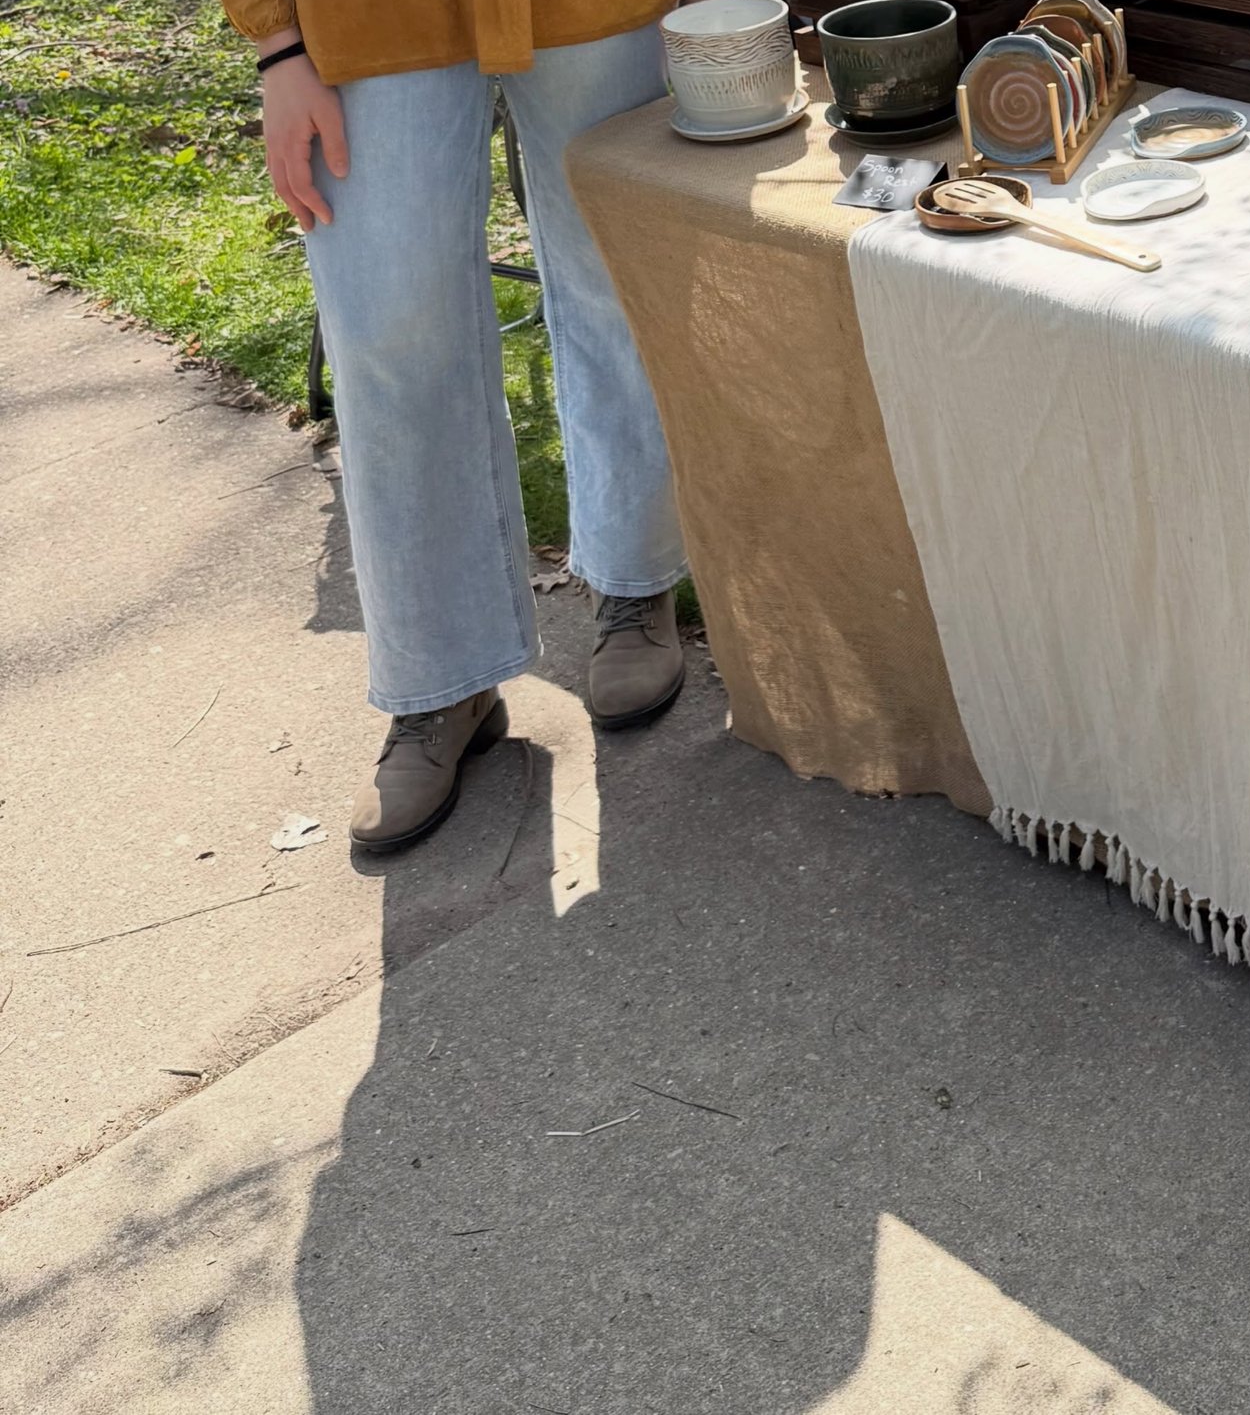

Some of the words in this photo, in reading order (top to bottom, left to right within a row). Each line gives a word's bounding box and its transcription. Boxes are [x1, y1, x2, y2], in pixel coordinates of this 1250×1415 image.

[861, 159, 904, 178] Spoon
[883, 175, 919, 187] Rest
[861, 187, 895, 203] $30
